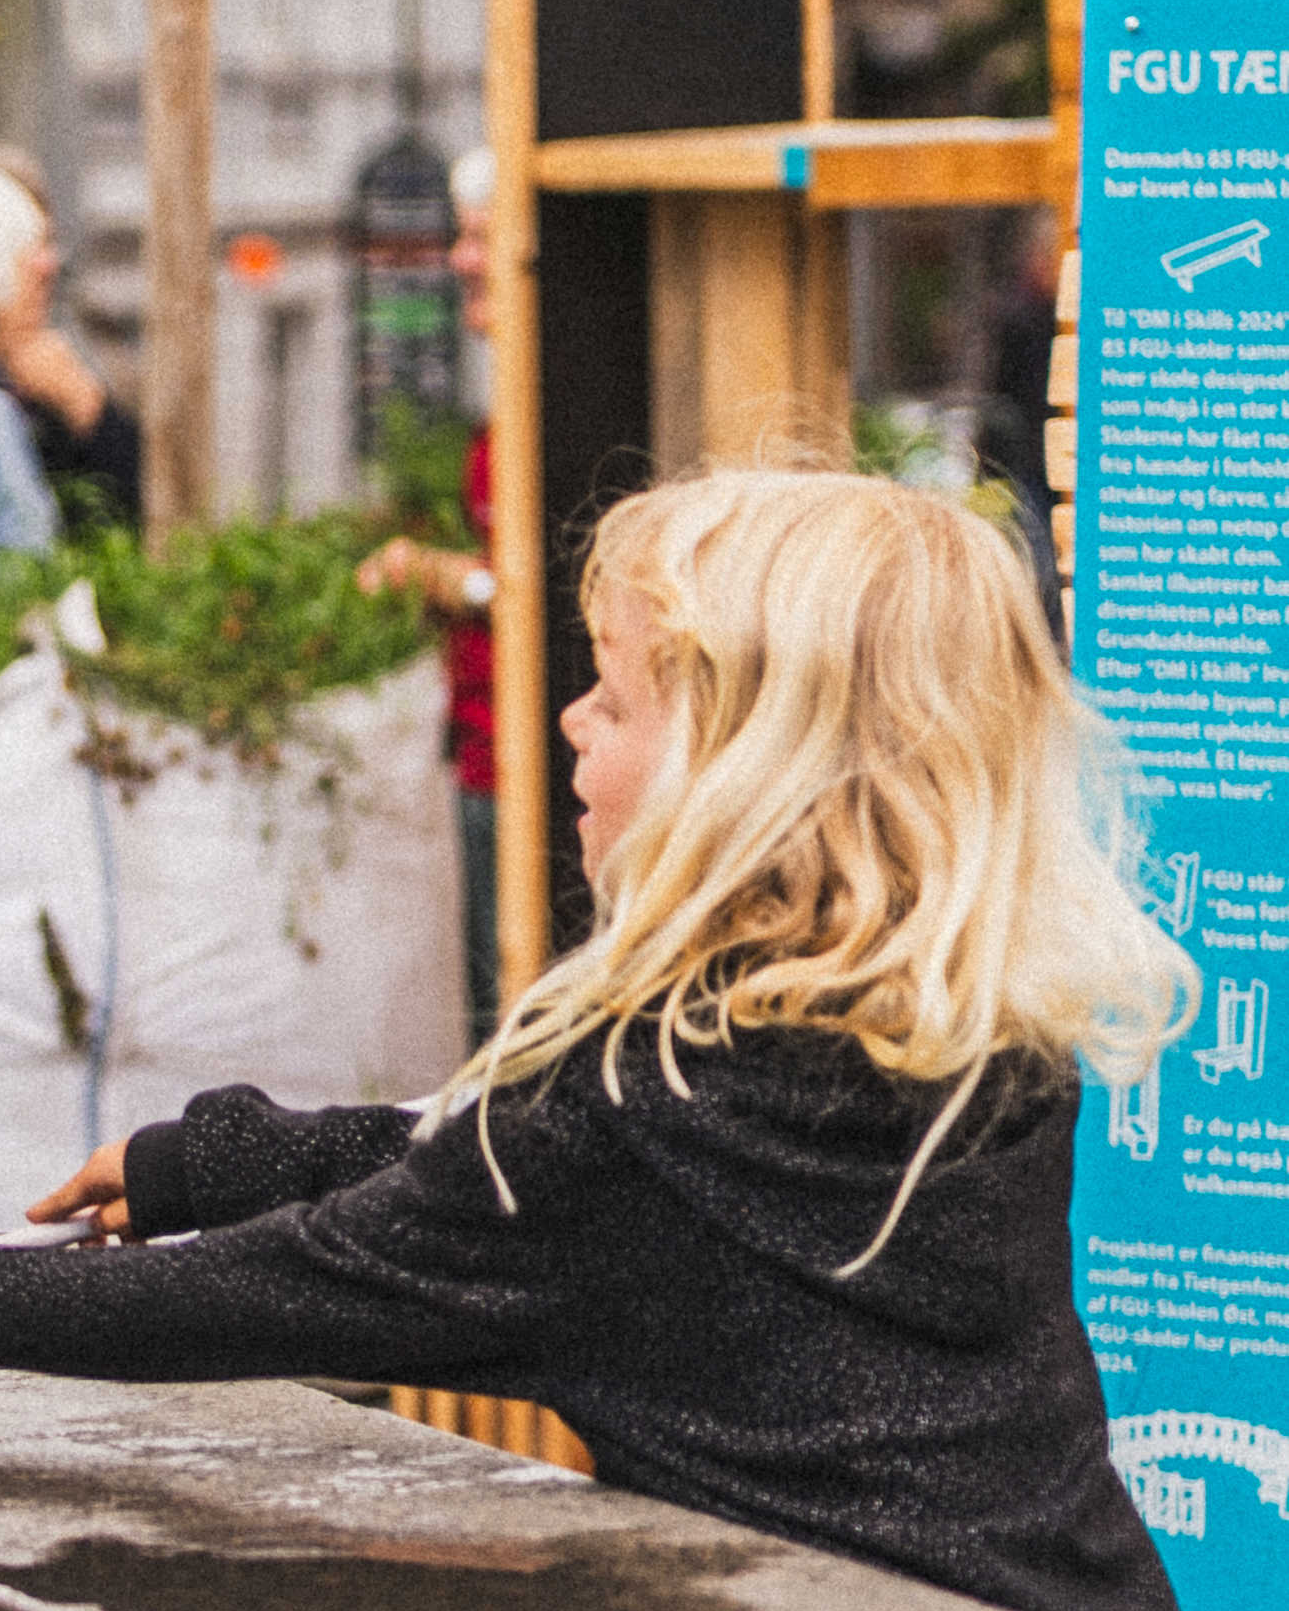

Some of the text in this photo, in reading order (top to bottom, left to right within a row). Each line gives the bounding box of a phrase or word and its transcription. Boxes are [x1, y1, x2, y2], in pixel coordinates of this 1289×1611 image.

[1108, 49, 1202, 95] FGU
[1173, 310, 1181, 330] i
[1183, 309, 1234, 331] Skills
[1202, 397, 1210, 418] i
[1212, 455, 1220, 476] i
[1190, 660, 1198, 681] i
[1202, 869, 1244, 891] FGU
[1183, 1114, 1204, 1135] Er
[1207, 1116, 1233, 1137] du
[1206, 1144, 1233, 1166] du
[1179, 1247, 1198, 1263] er
